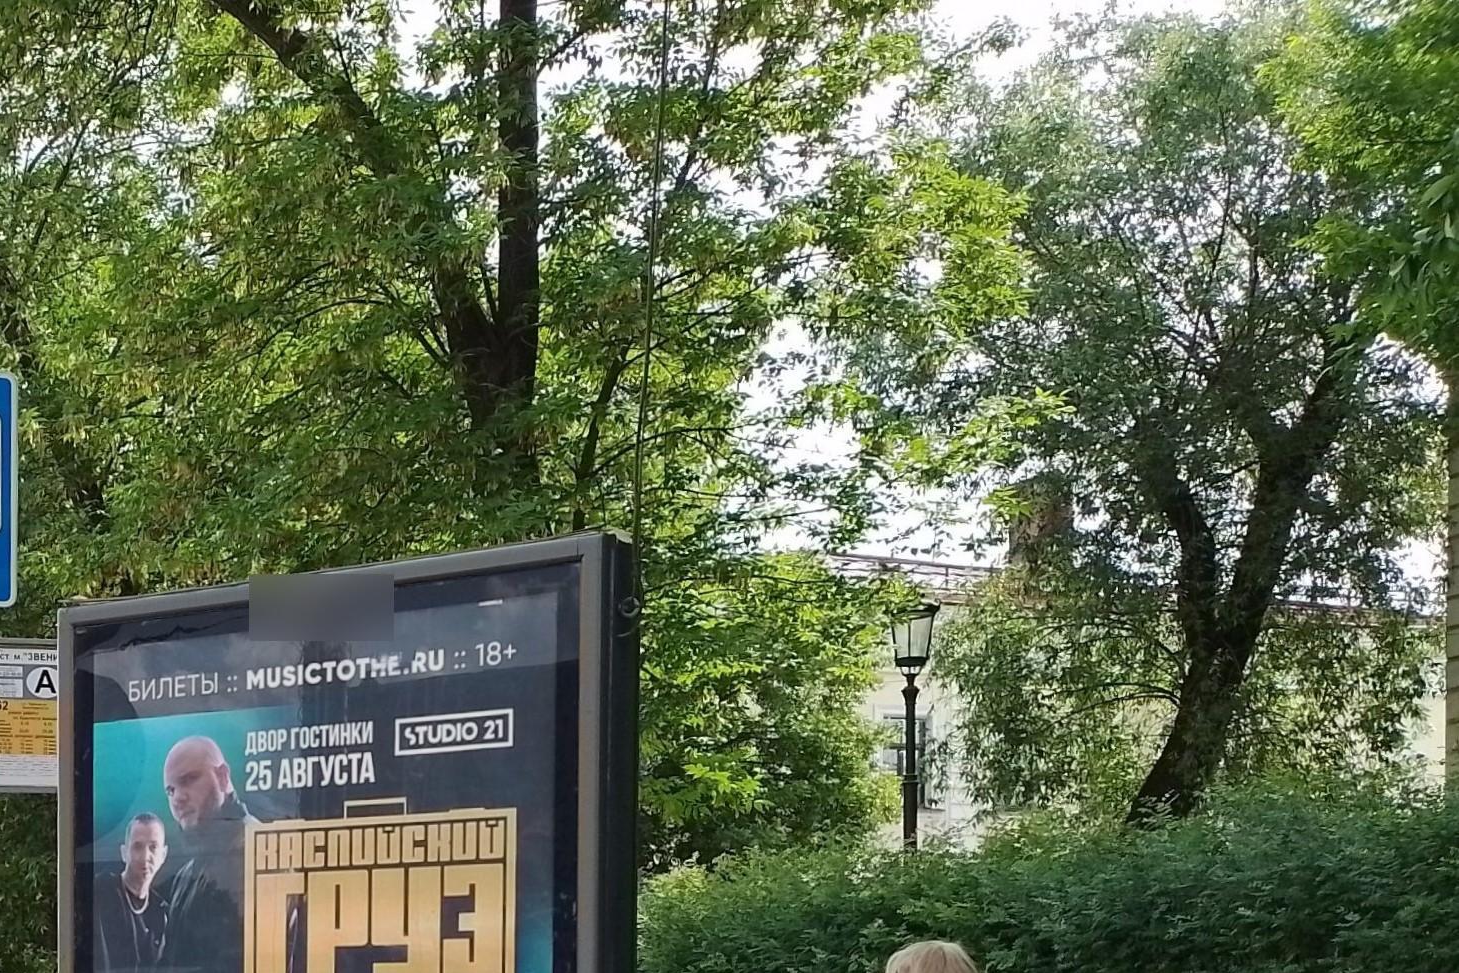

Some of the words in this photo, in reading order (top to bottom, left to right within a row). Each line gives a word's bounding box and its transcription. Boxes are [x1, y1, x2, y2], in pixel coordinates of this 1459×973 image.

[34, 669, 57, 694] А
[128, 671, 219, 702] БИЛЕТЫ
[246, 650, 445, 690] MUSICTOTHE.RU
[475, 642, 517, 667] 18+
[245, 728, 287, 757] ДВОР
[290, 721, 374, 750] ГОСТИНКИ
[404, 722, 477, 747] STUDIO
[483, 719, 505, 739] 21
[245, 759, 273, 792] 25
[277, 752, 375, 790] АВГУСТА
